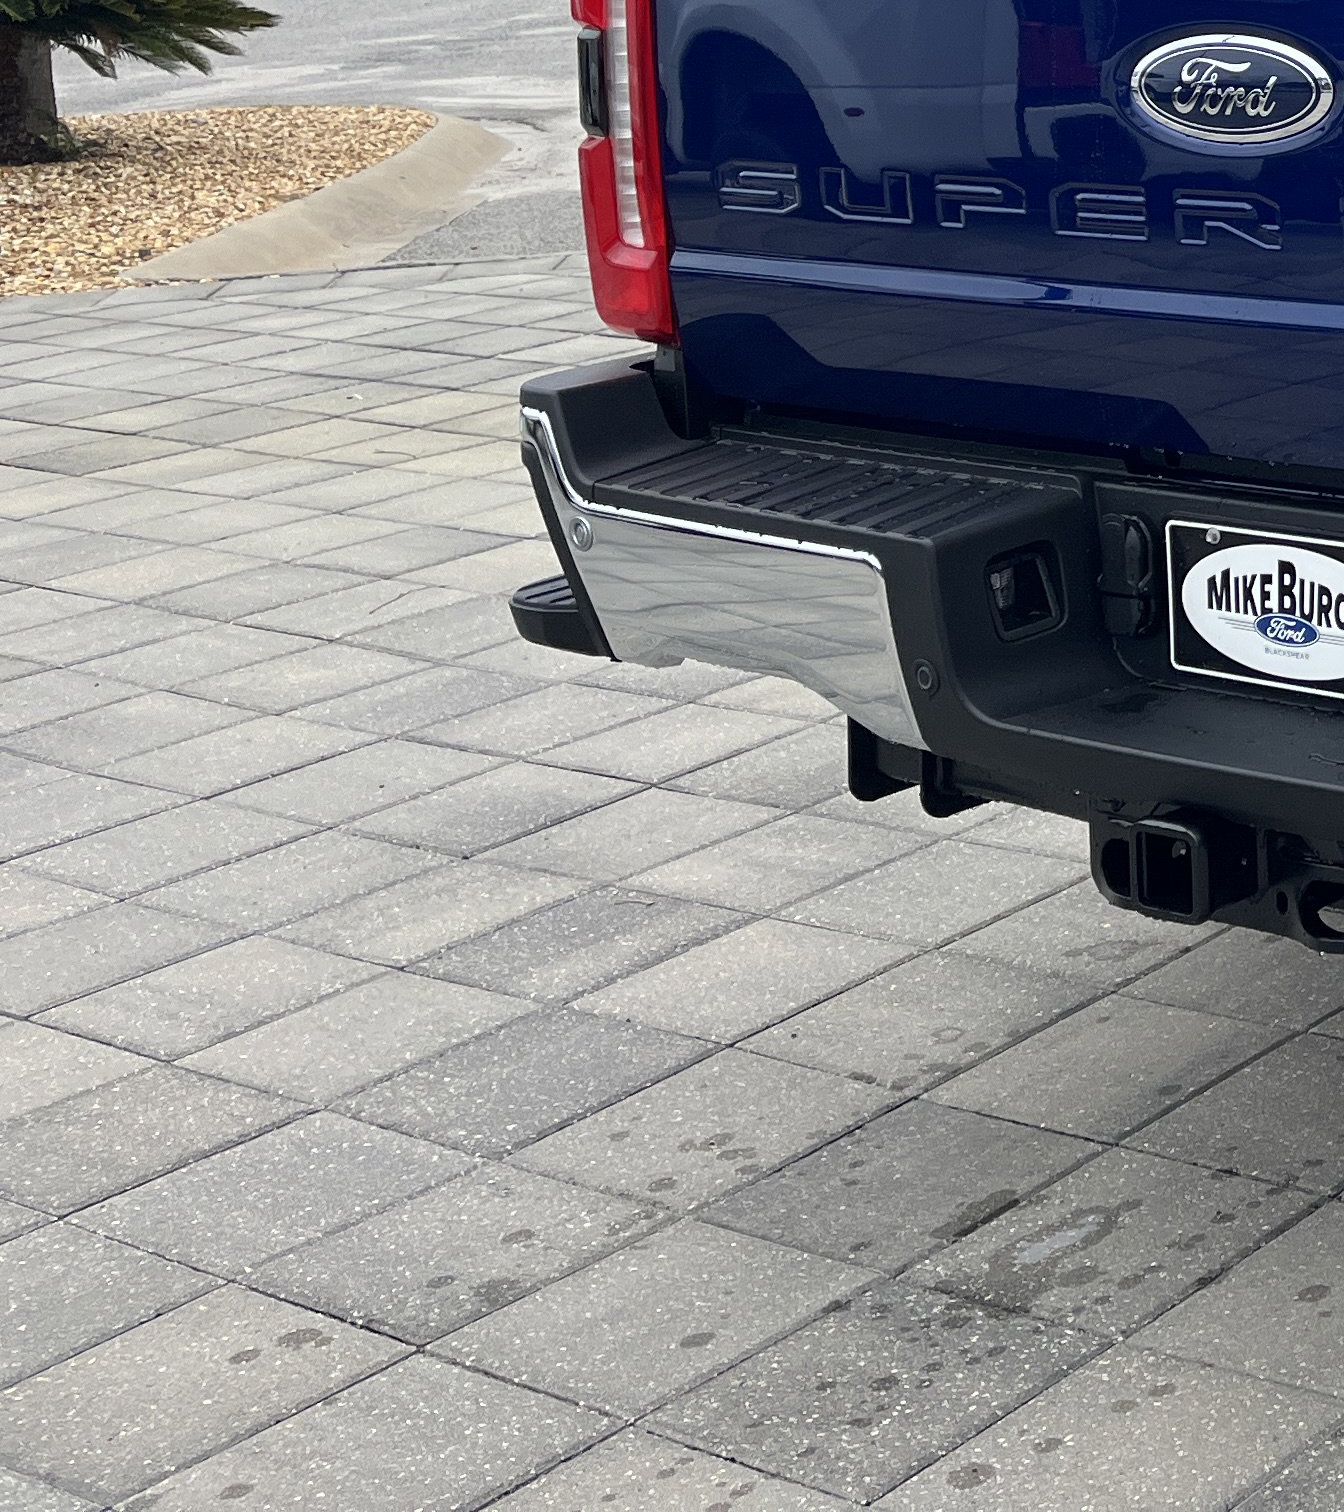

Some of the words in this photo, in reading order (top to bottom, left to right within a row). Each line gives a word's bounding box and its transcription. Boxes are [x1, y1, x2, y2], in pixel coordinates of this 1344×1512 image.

[1172, 57, 1278, 118] Ford
[715, 158, 1284, 250] SUPER
[1266, 617, 1307, 644] Ford
[1264, 645, 1311, 661] BLACKSHEAR
